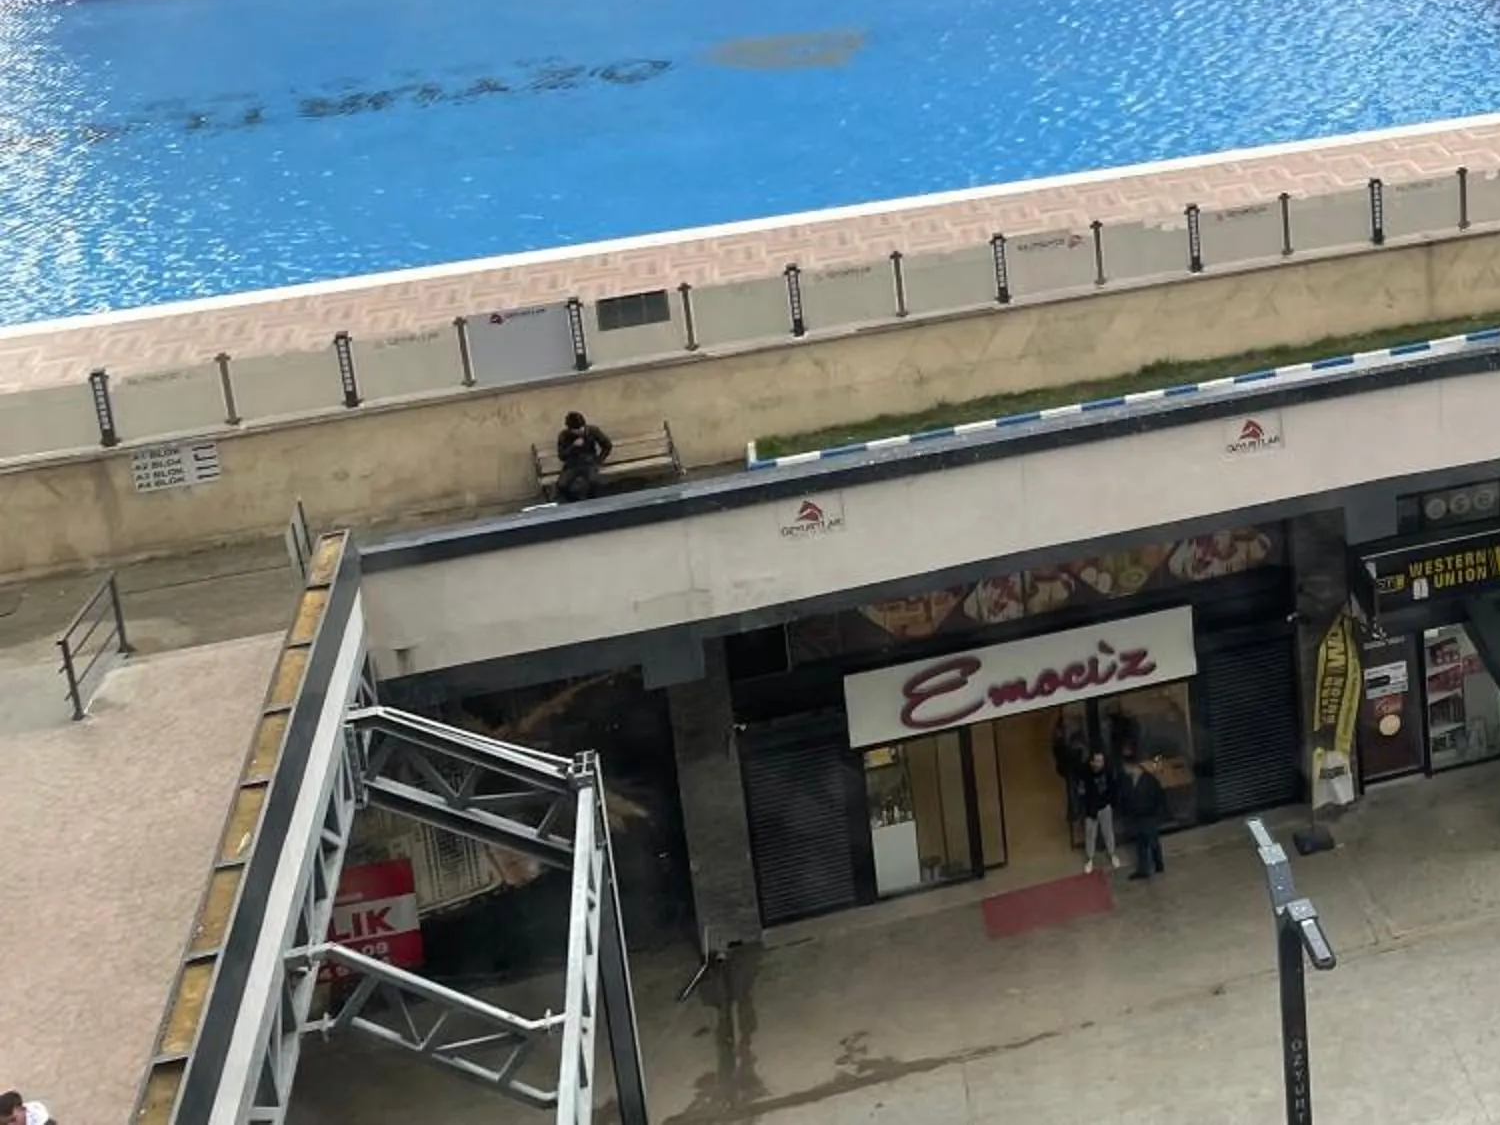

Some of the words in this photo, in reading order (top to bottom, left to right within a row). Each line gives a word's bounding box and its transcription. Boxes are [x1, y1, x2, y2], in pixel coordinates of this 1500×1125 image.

[1409, 548, 1487, 578] WESTERN
[1433, 567, 1487, 589] UNION
[327, 906, 396, 942] LIK
